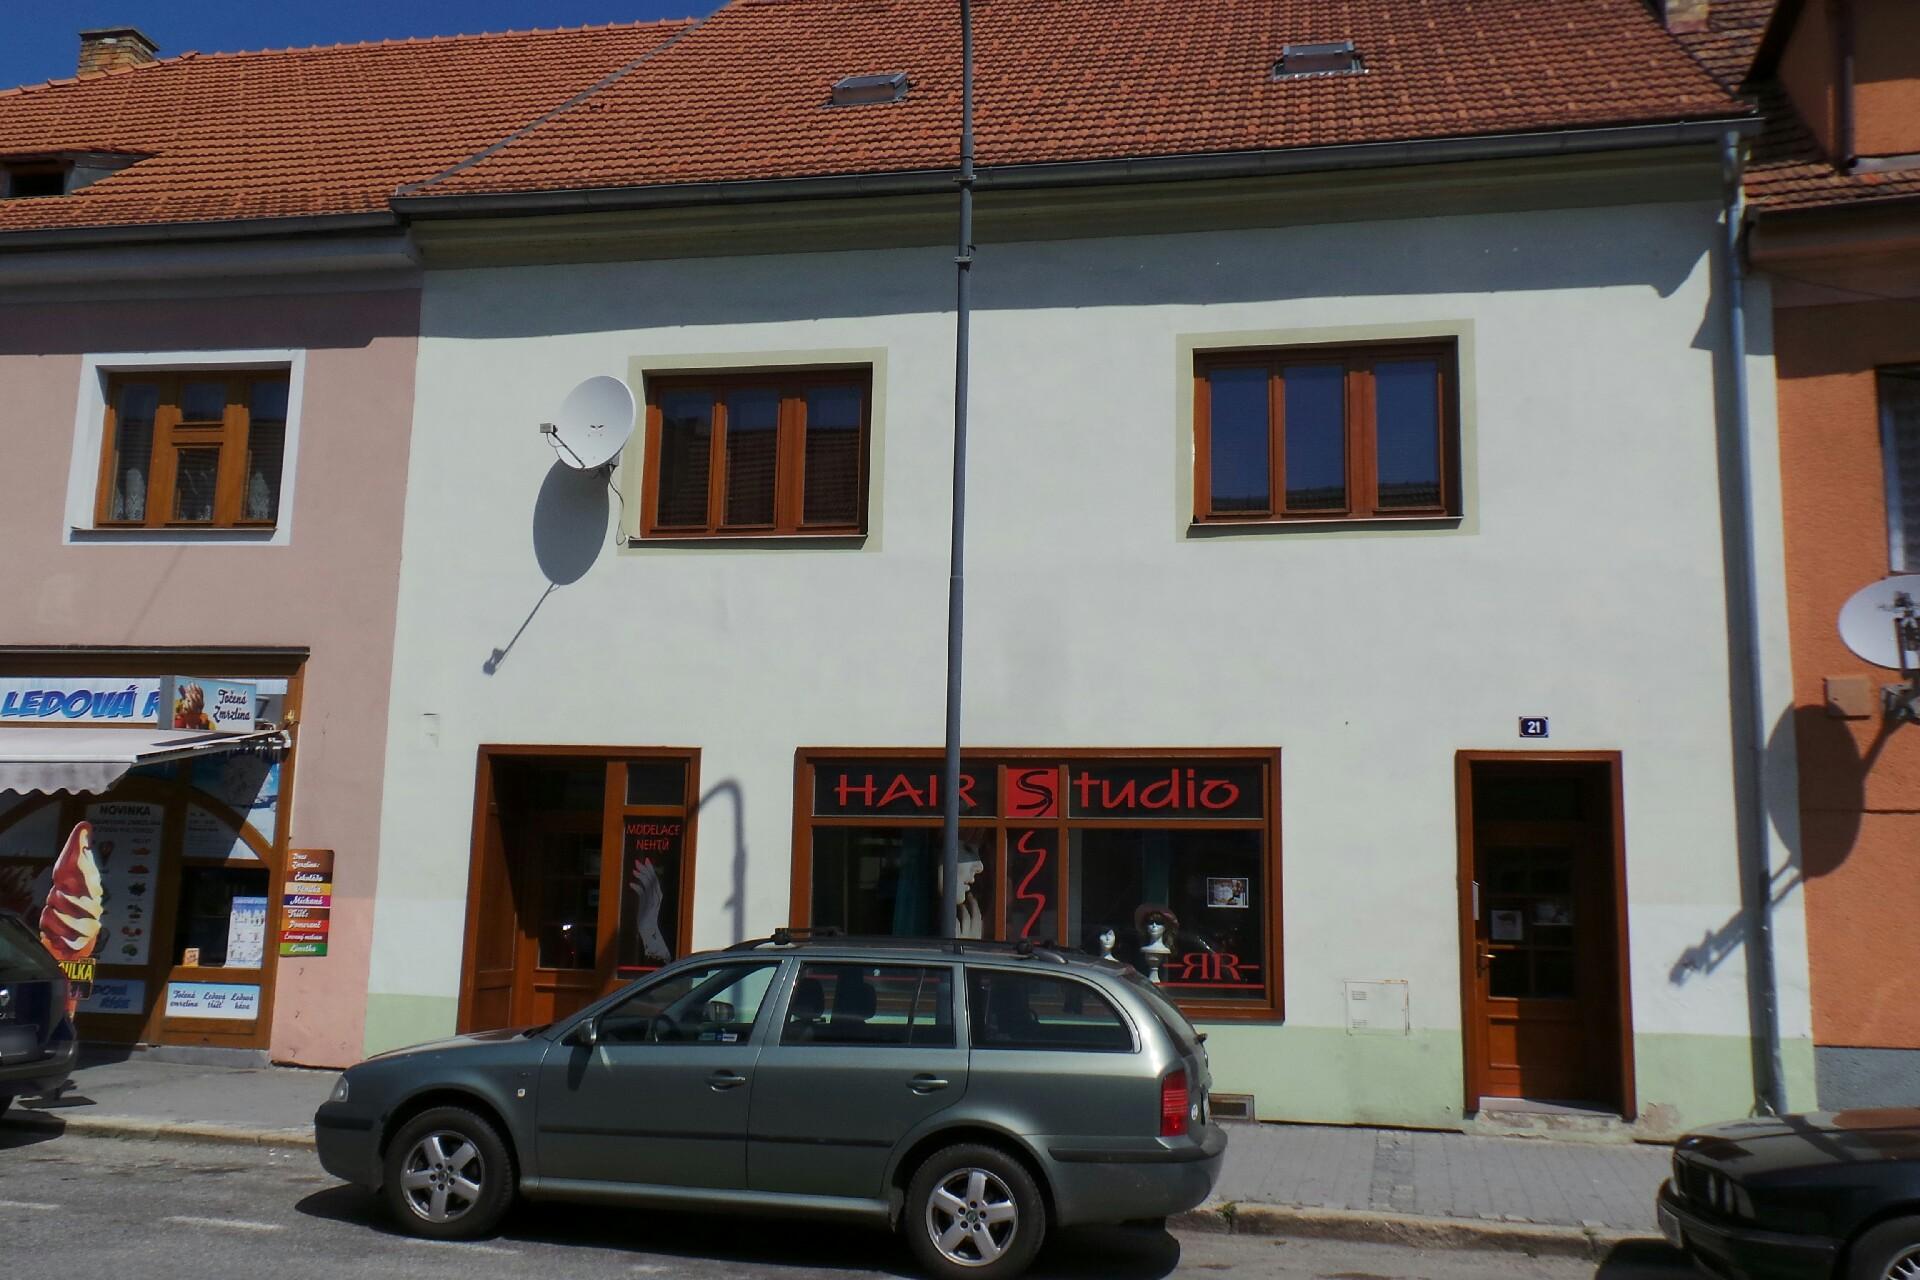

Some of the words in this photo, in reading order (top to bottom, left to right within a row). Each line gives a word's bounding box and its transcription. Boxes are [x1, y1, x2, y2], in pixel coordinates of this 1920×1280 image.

[1, 685, 139, 718] LEDOVÁ
[218, 689, 248, 704] Točená
[1527, 721, 1541, 734] 21
[834, 774, 977, 807] HAIR
[99, 805, 151, 816] NOVINKA
[626, 823, 681, 836] MODELACE
